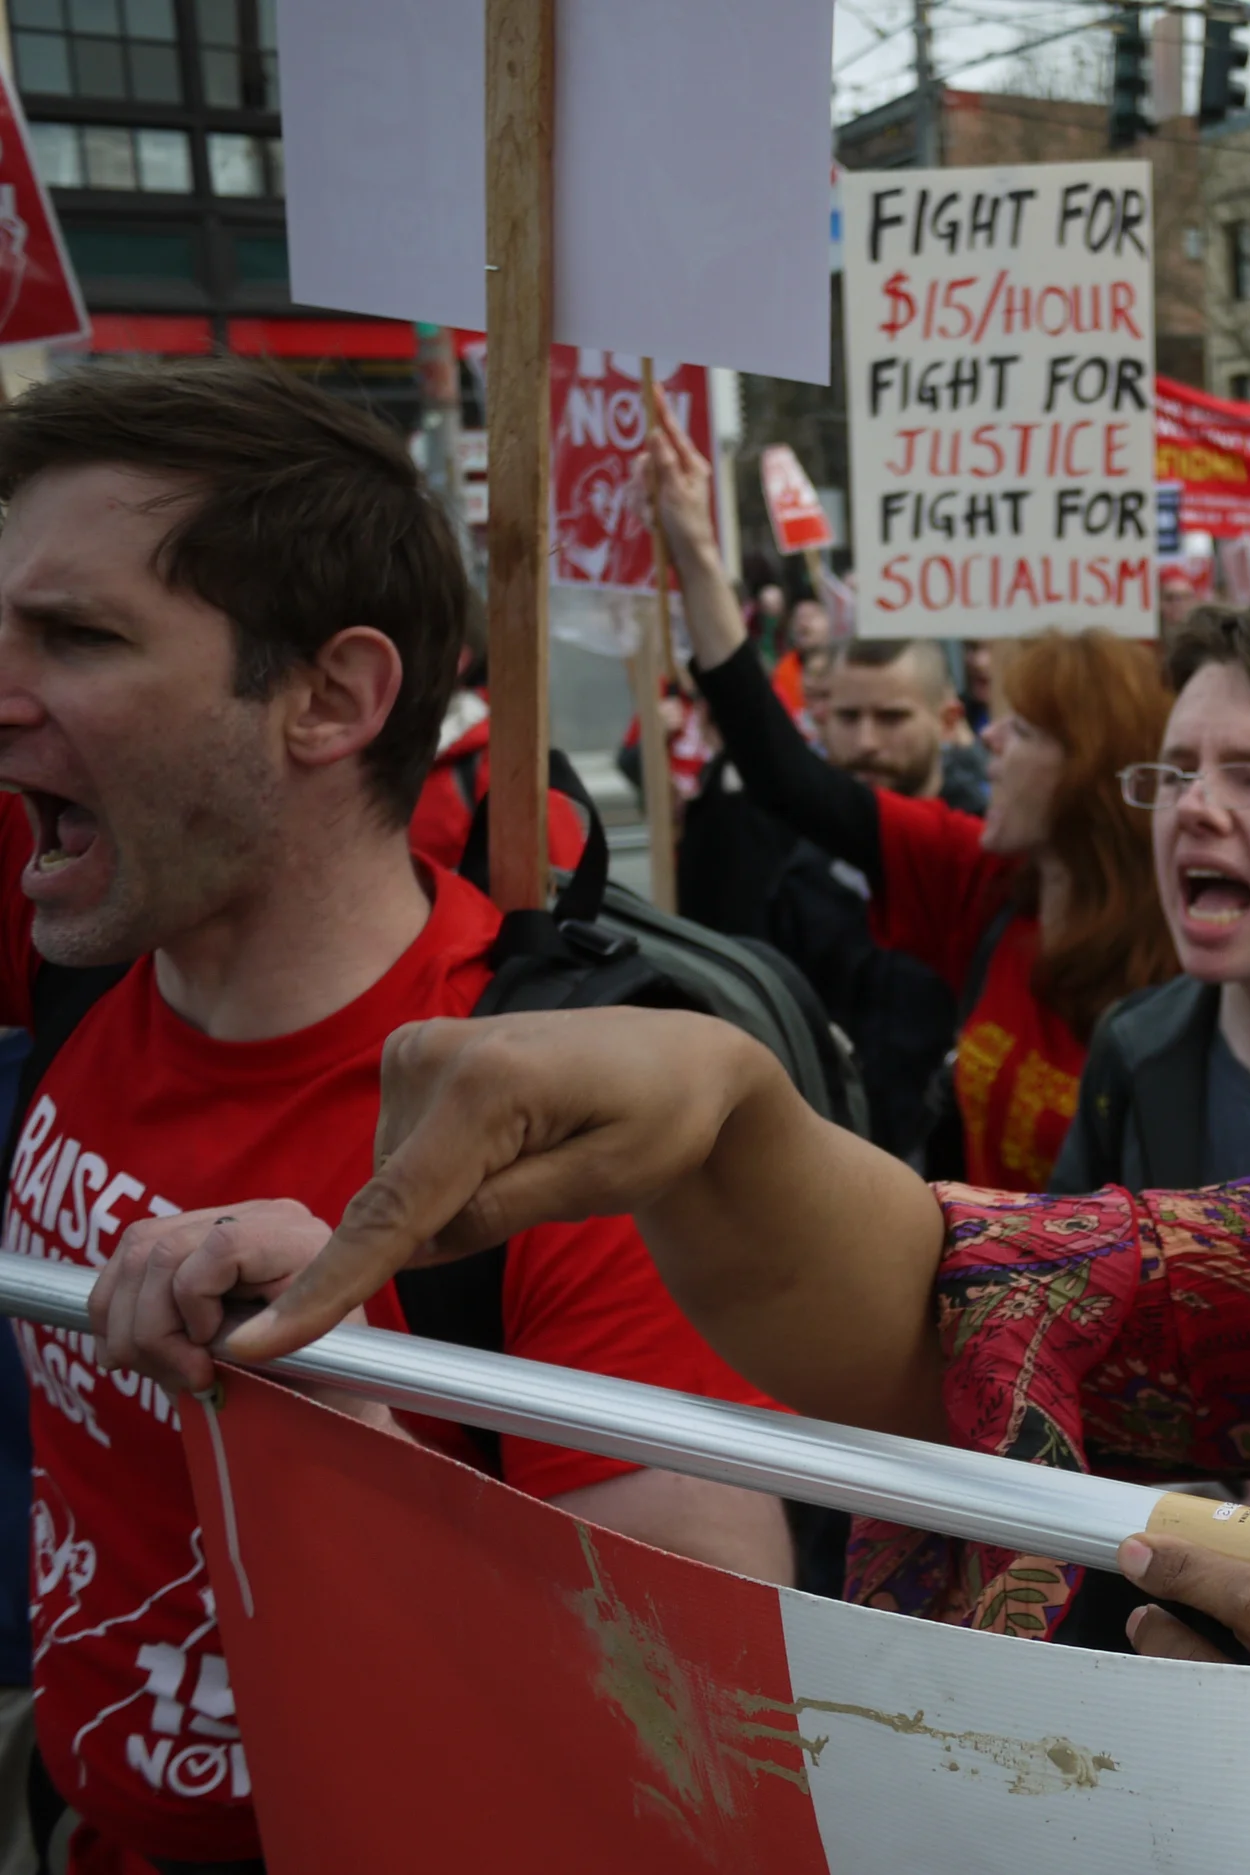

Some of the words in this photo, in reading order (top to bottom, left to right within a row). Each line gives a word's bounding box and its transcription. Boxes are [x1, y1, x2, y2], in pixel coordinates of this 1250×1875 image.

[868, 188, 1037, 264] FIGHT
[1058, 182, 1149, 259] FOR
[879, 268, 1145, 345] $15/HOUR
[869, 354, 1022, 418] FIGHT
[1043, 354, 1148, 413] FOR
[885, 420, 1131, 480] JUSTICE
[880, 489, 1032, 545] FIGHT
[1055, 487, 1148, 541] FOR
[874, 553, 1151, 613] SOCIALISM
[9, 1094, 146, 1268] RAISE
